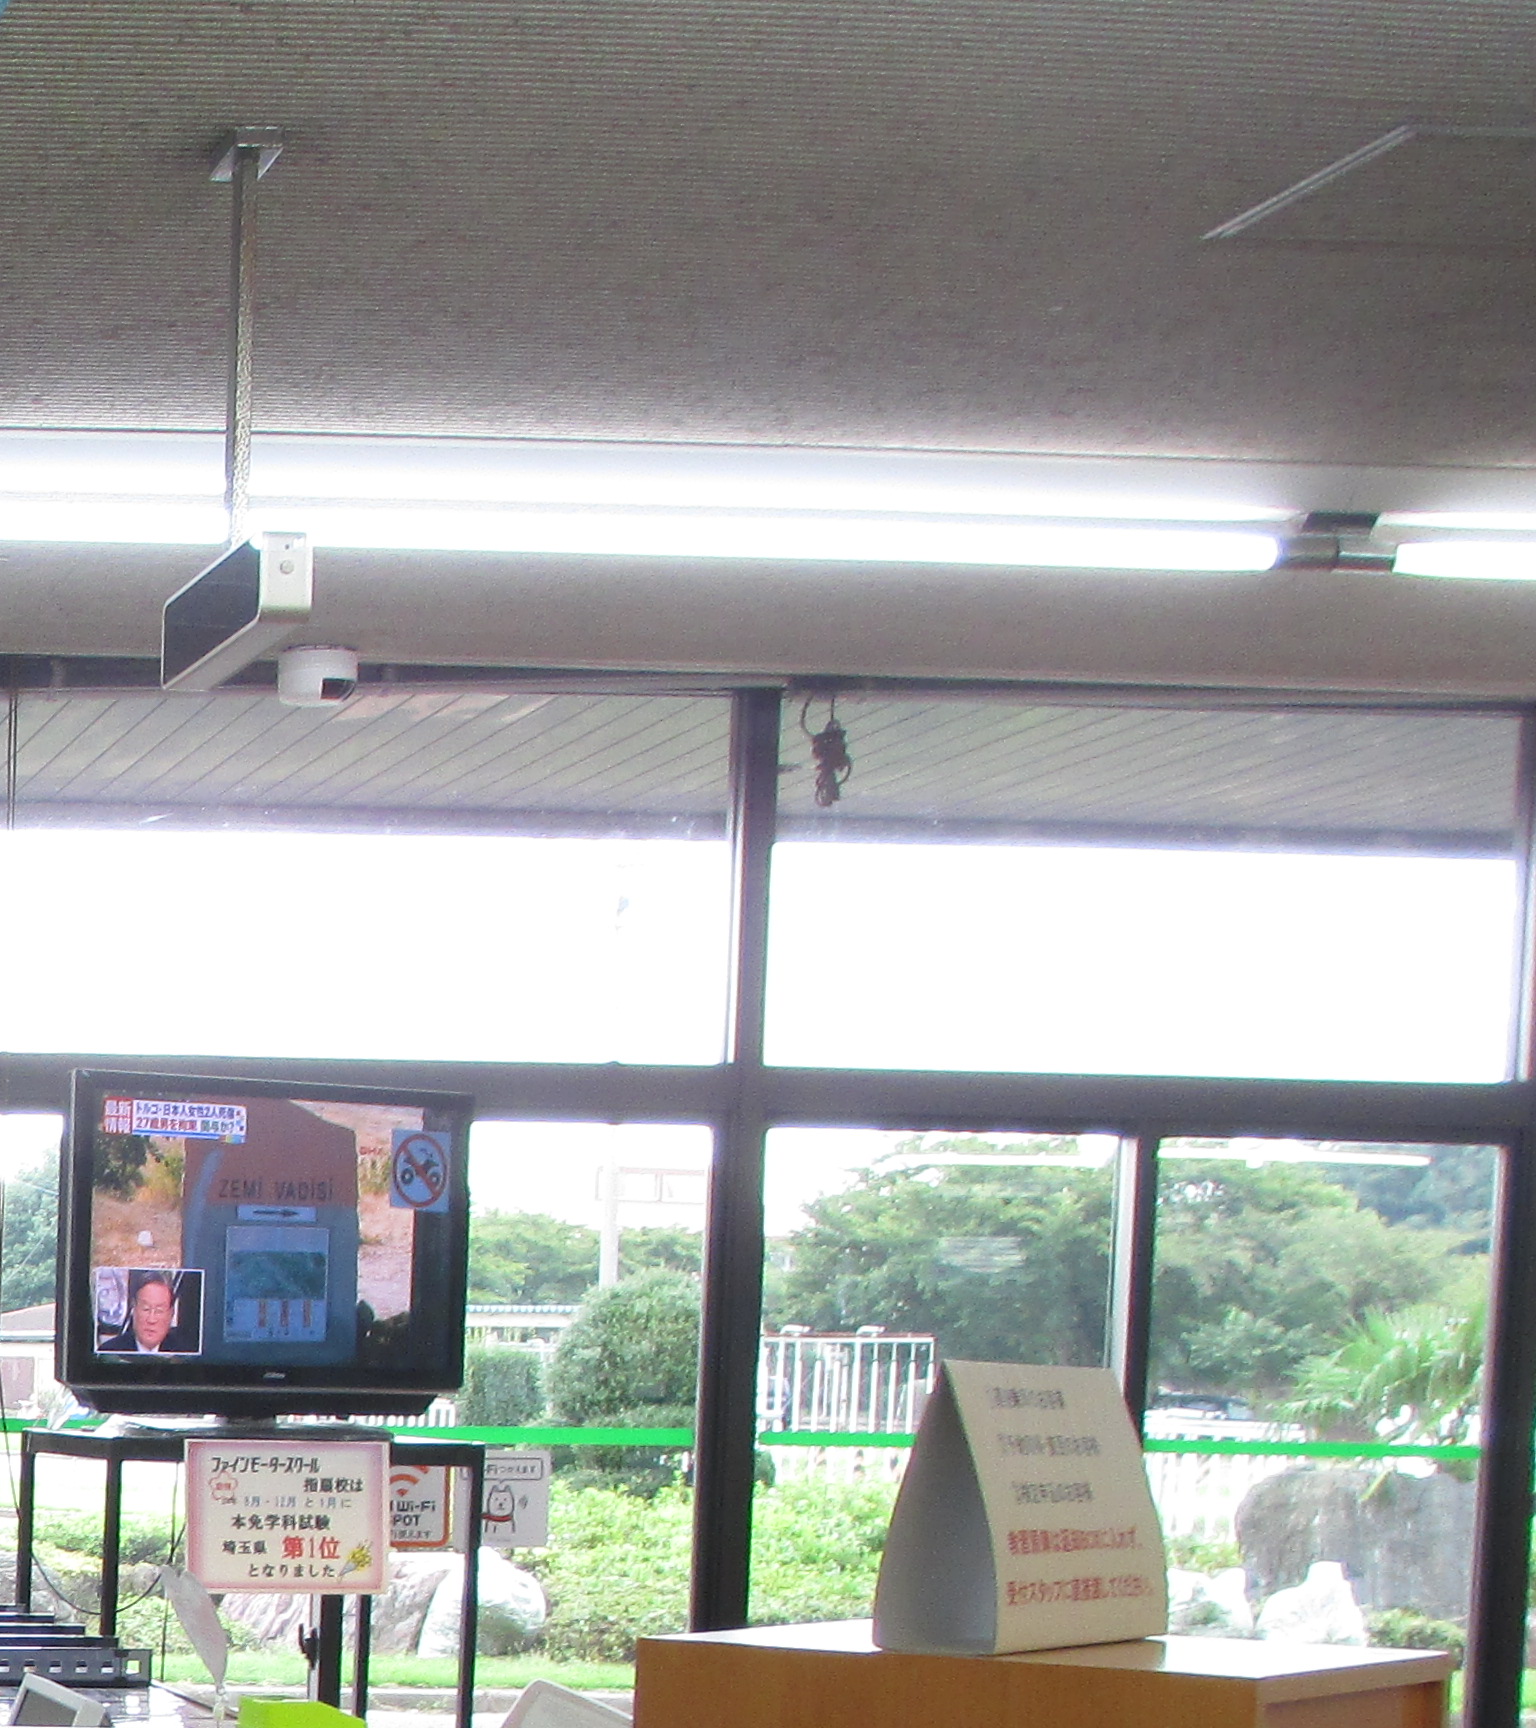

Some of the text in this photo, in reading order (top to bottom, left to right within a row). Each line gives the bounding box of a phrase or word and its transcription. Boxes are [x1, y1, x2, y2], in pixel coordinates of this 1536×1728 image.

[211, 1456, 320, 1473] ファインモータースクール
[485, 1464, 536, 1474] Fiつかえます
[396, 1500, 436, 1511] Wi-Fi
[232, 1514, 331, 1531] 本免学科試験
[391, 1514, 421, 1526] POT
[282, 1535, 341, 1560] 第1位
